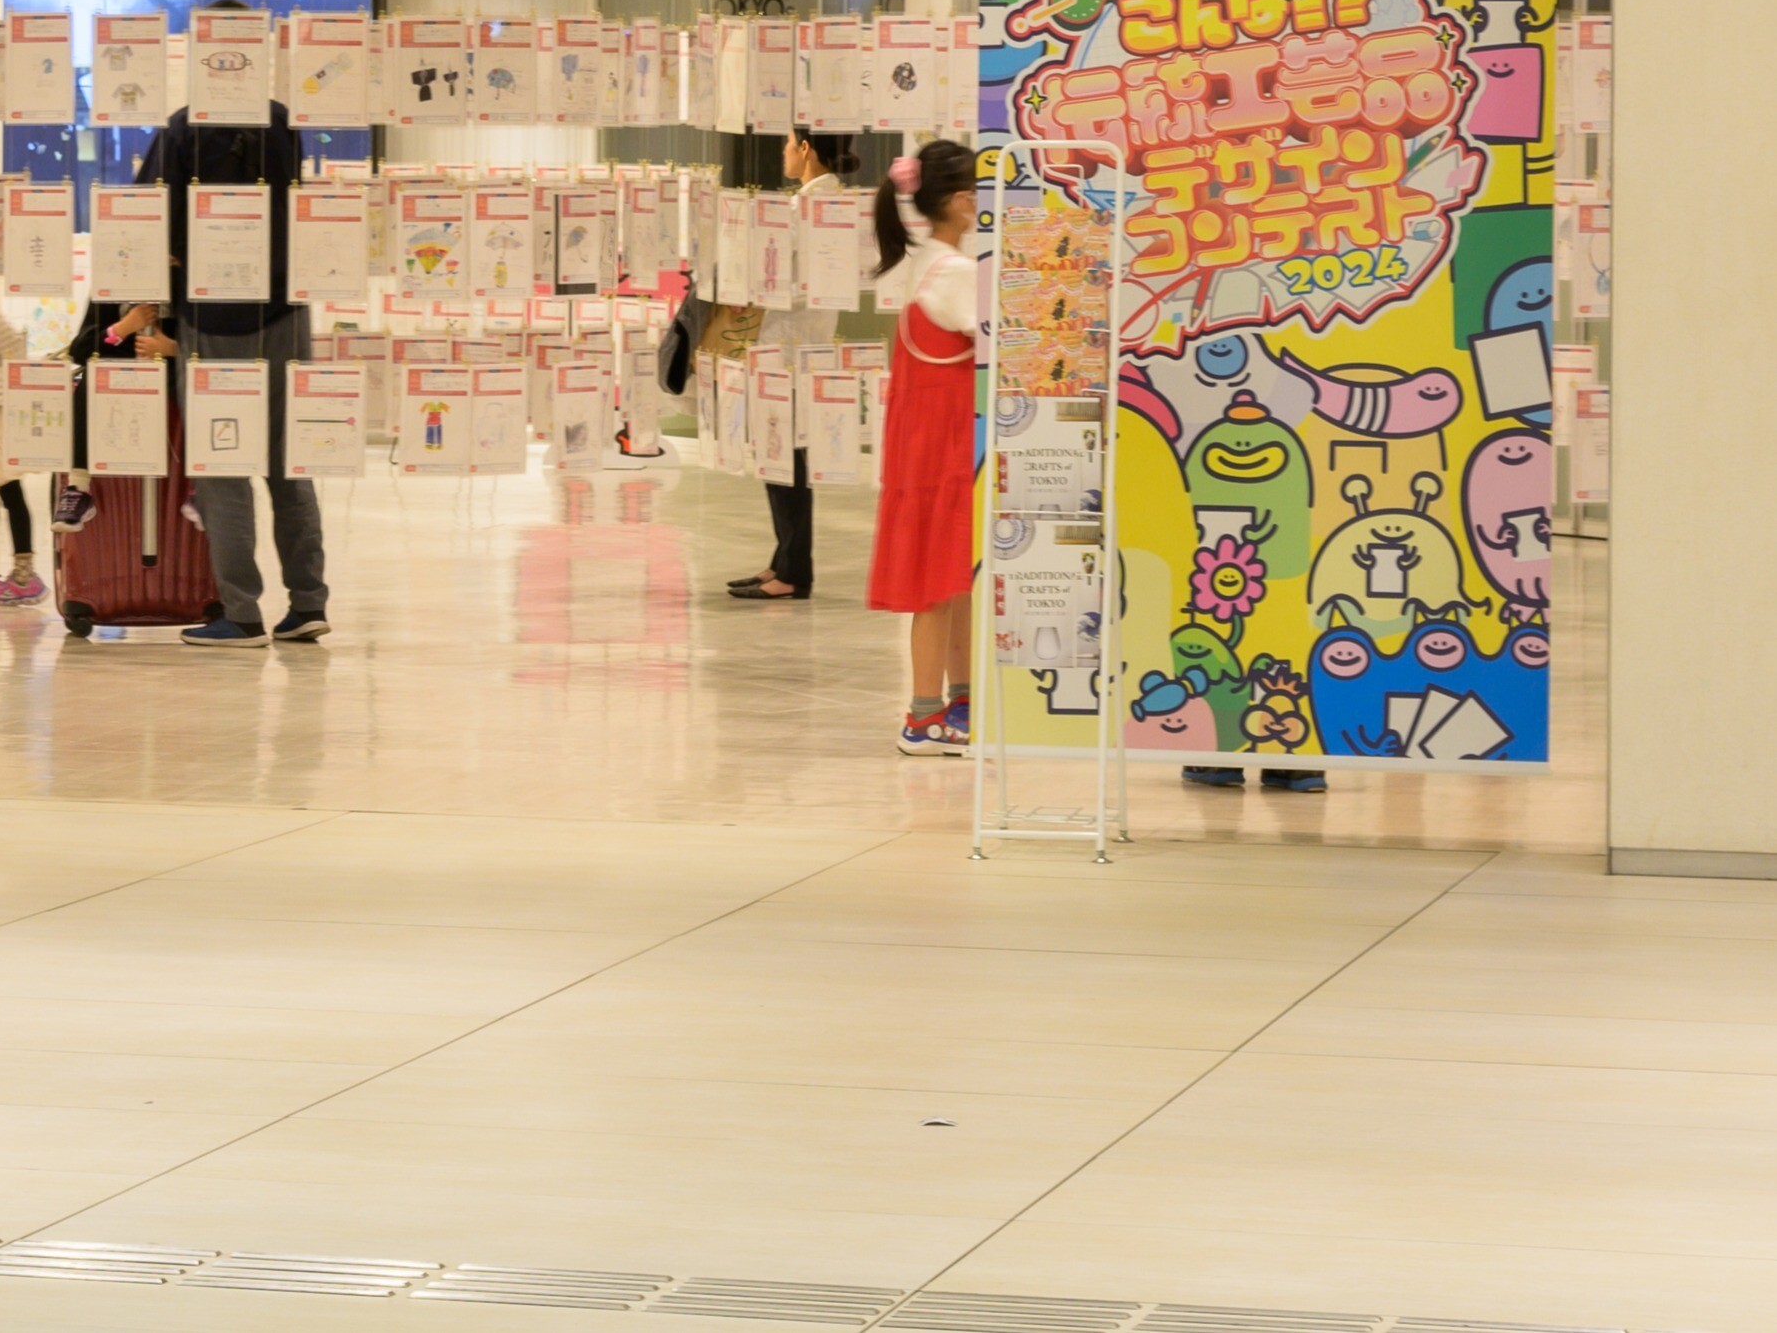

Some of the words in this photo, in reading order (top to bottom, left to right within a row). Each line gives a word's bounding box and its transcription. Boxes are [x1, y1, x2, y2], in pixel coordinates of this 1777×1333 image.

[1030, 28, 1446, 163] 伝統工芸品
[1144, 127, 1407, 215] デザイン
[1126, 187, 1433, 275] コンテスト
[1277, 245, 1407, 295] 2024
[1029, 476, 1068, 485] TOKYO
[1026, 599, 1066, 608] TOKYO
